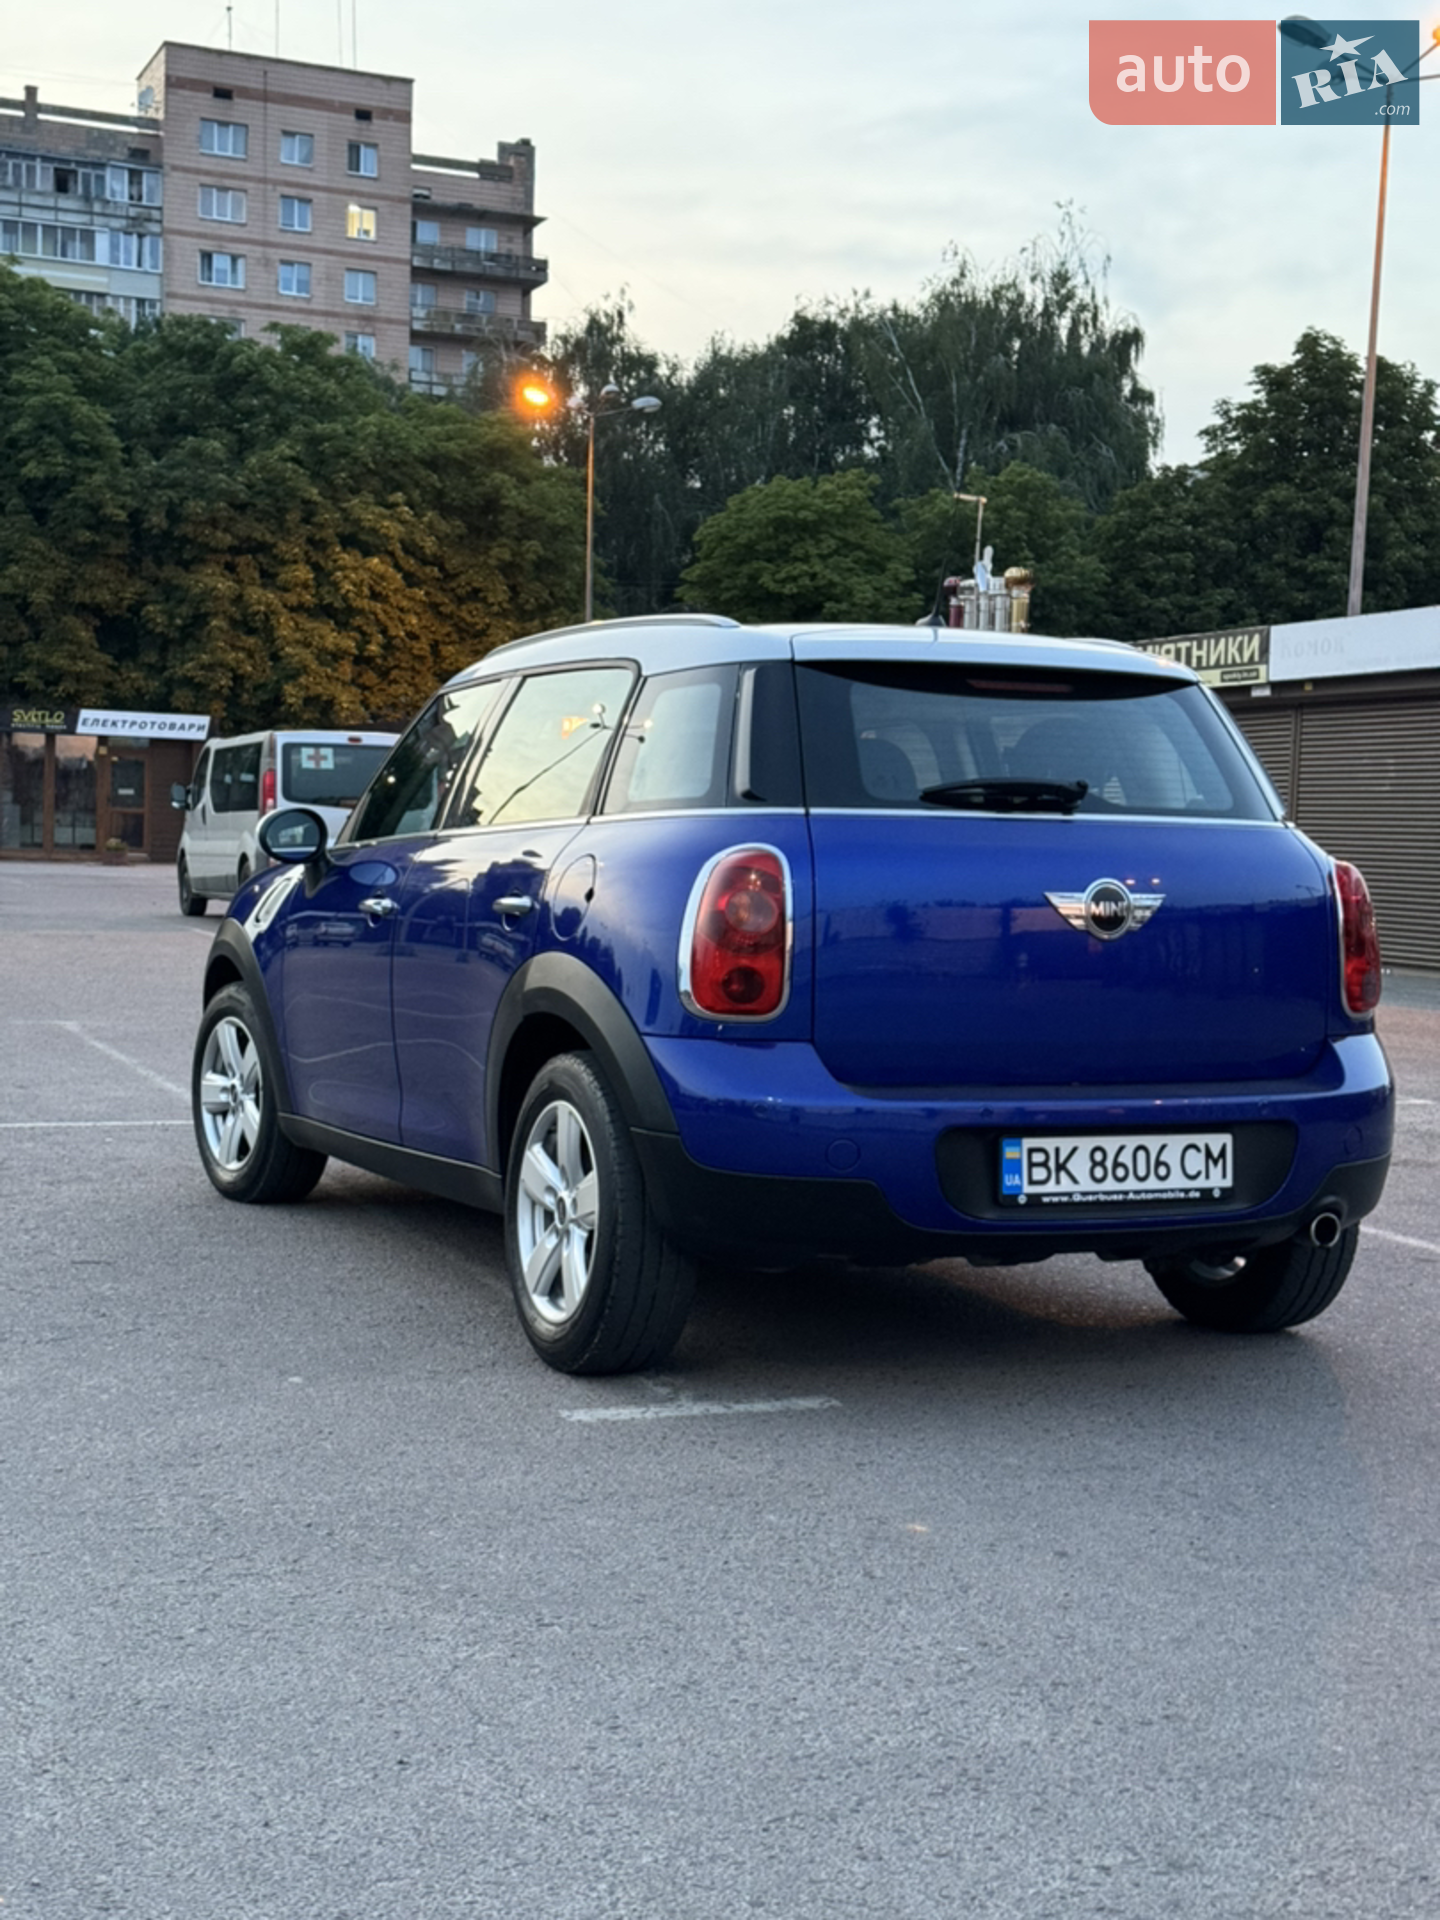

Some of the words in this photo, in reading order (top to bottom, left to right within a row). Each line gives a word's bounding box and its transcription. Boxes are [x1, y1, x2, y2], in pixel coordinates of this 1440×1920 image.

[80, 716, 207, 733] ЕЛЕКТРОТОВАРИ
[1090, 900, 1127, 918] MINI
[1026, 1145, 1081, 1187] BK
[1088, 1143, 1172, 1184] 8606
[1180, 1141, 1228, 1182] CM
[1004, 1173, 1022, 1187] UA
